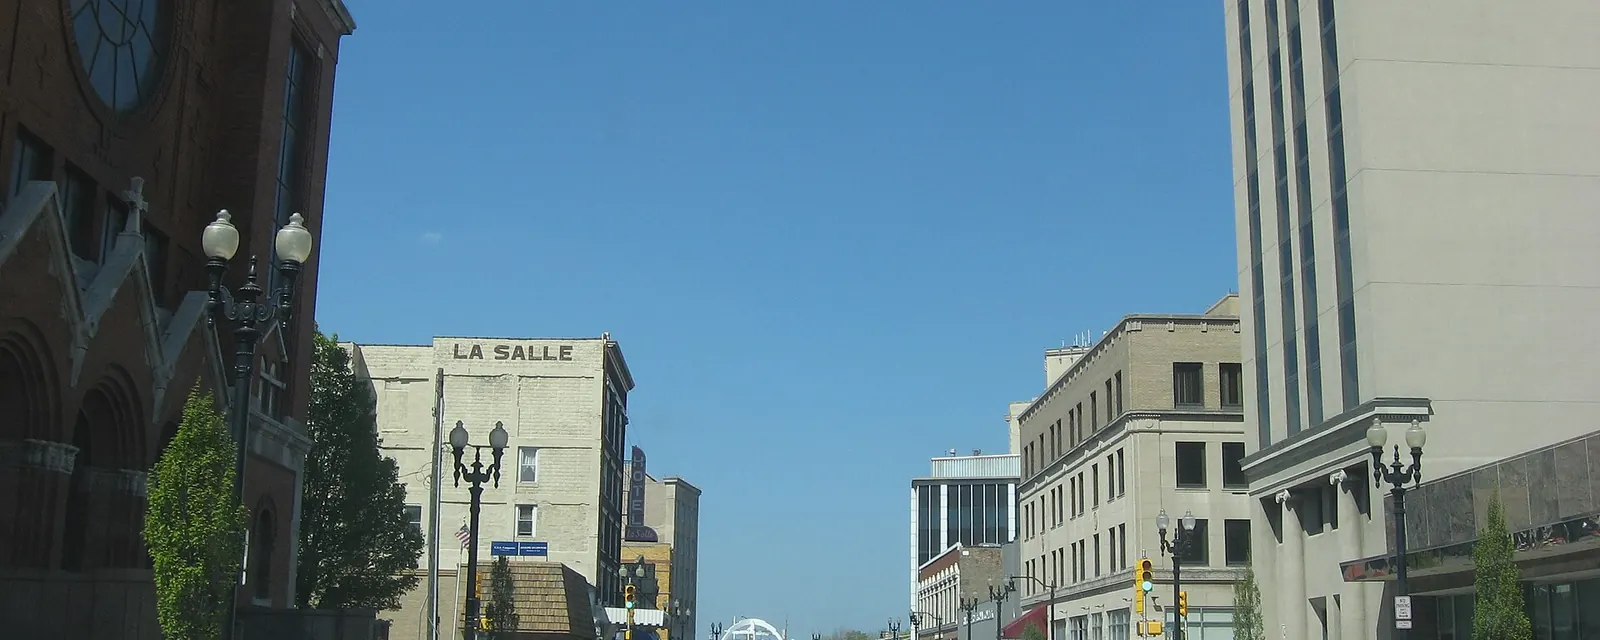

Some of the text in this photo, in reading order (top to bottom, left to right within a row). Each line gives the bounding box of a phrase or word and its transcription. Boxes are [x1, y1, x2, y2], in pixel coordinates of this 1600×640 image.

[454, 344, 573, 361] LA SALLE
[632, 456, 644, 524] HOTEL
